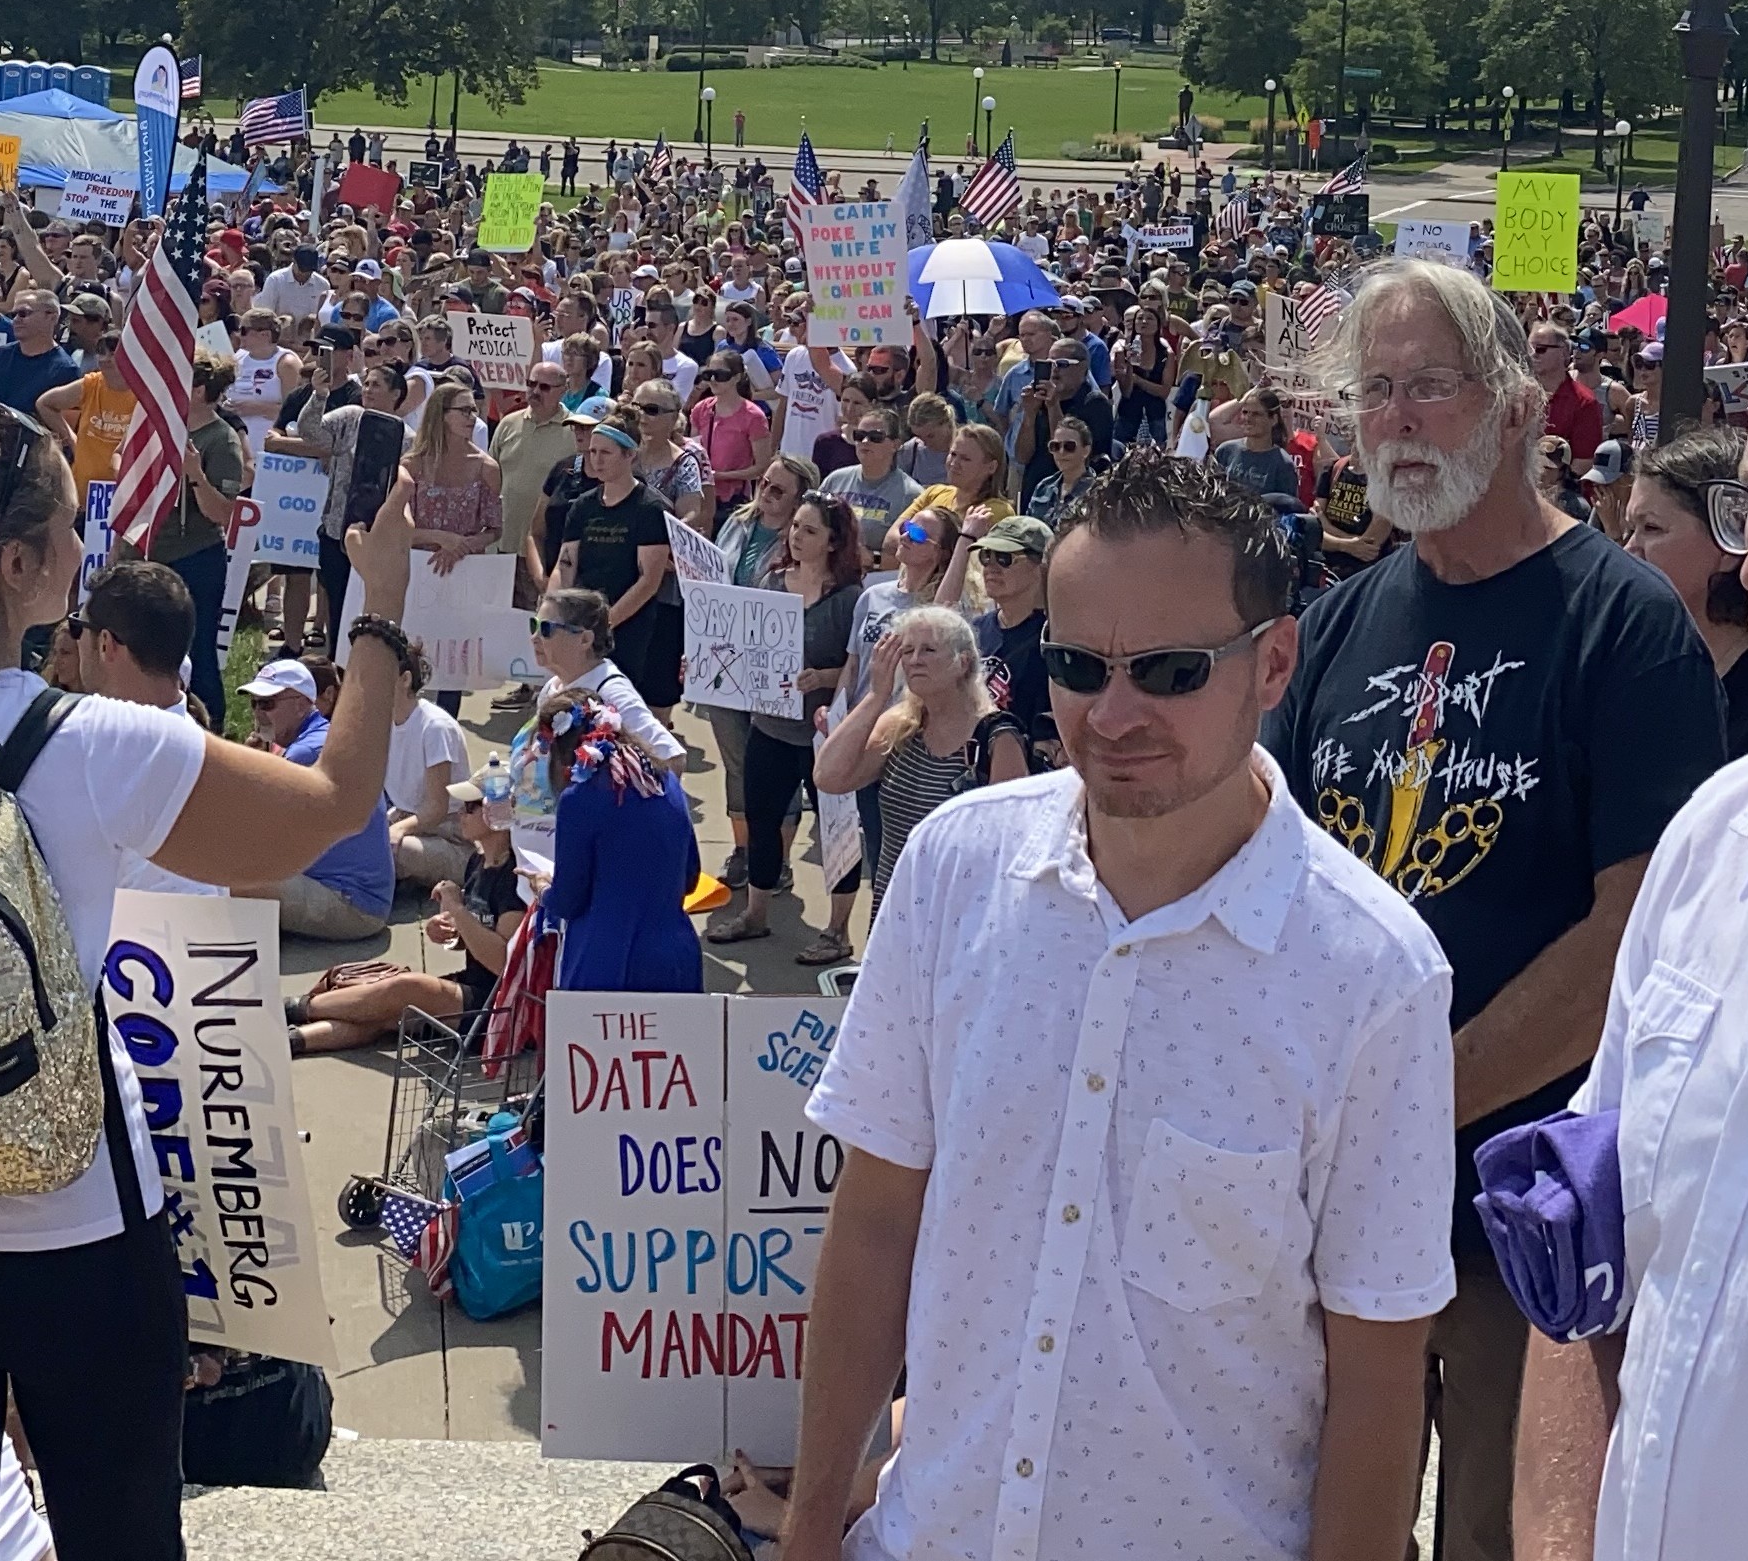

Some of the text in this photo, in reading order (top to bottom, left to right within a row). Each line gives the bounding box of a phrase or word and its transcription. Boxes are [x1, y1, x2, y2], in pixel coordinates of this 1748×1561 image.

[70, 169, 112, 185] MEDICAL
[1512, 178, 1557, 202] MY
[64, 192, 118, 210] STOP THE
[808, 209, 813, 224] I
[1504, 206, 1569, 233] BODY
[810, 223, 897, 241] POKE MY
[1143, 226, 1189, 237] FREEDOM
[1422, 224, 1442, 237] NO
[831, 241, 881, 258] WIFE
[1507, 232, 1553, 252] MY
[813, 261, 897, 280] WITHOUT
[1495, 255, 1571, 278] CHOICE
[858, 303, 893, 320] CAN
[467, 317, 516, 338] Protect
[468, 340, 527, 358] MEDICAL
[263, 456, 307, 474] STOP
[278, 496, 317, 513] GOD
[262, 534, 285, 552] US
[686, 587, 798, 648] SAY NO!
[593, 1011, 658, 1041] THE
[103, 939, 196, 1183] CODE
[567, 1042, 699, 1115] DATA
[186, 939, 279, 1310] NUREMBERG
[618, 1129, 844, 1198] DOES NO
[601, 1307, 812, 1381] MANDAT
